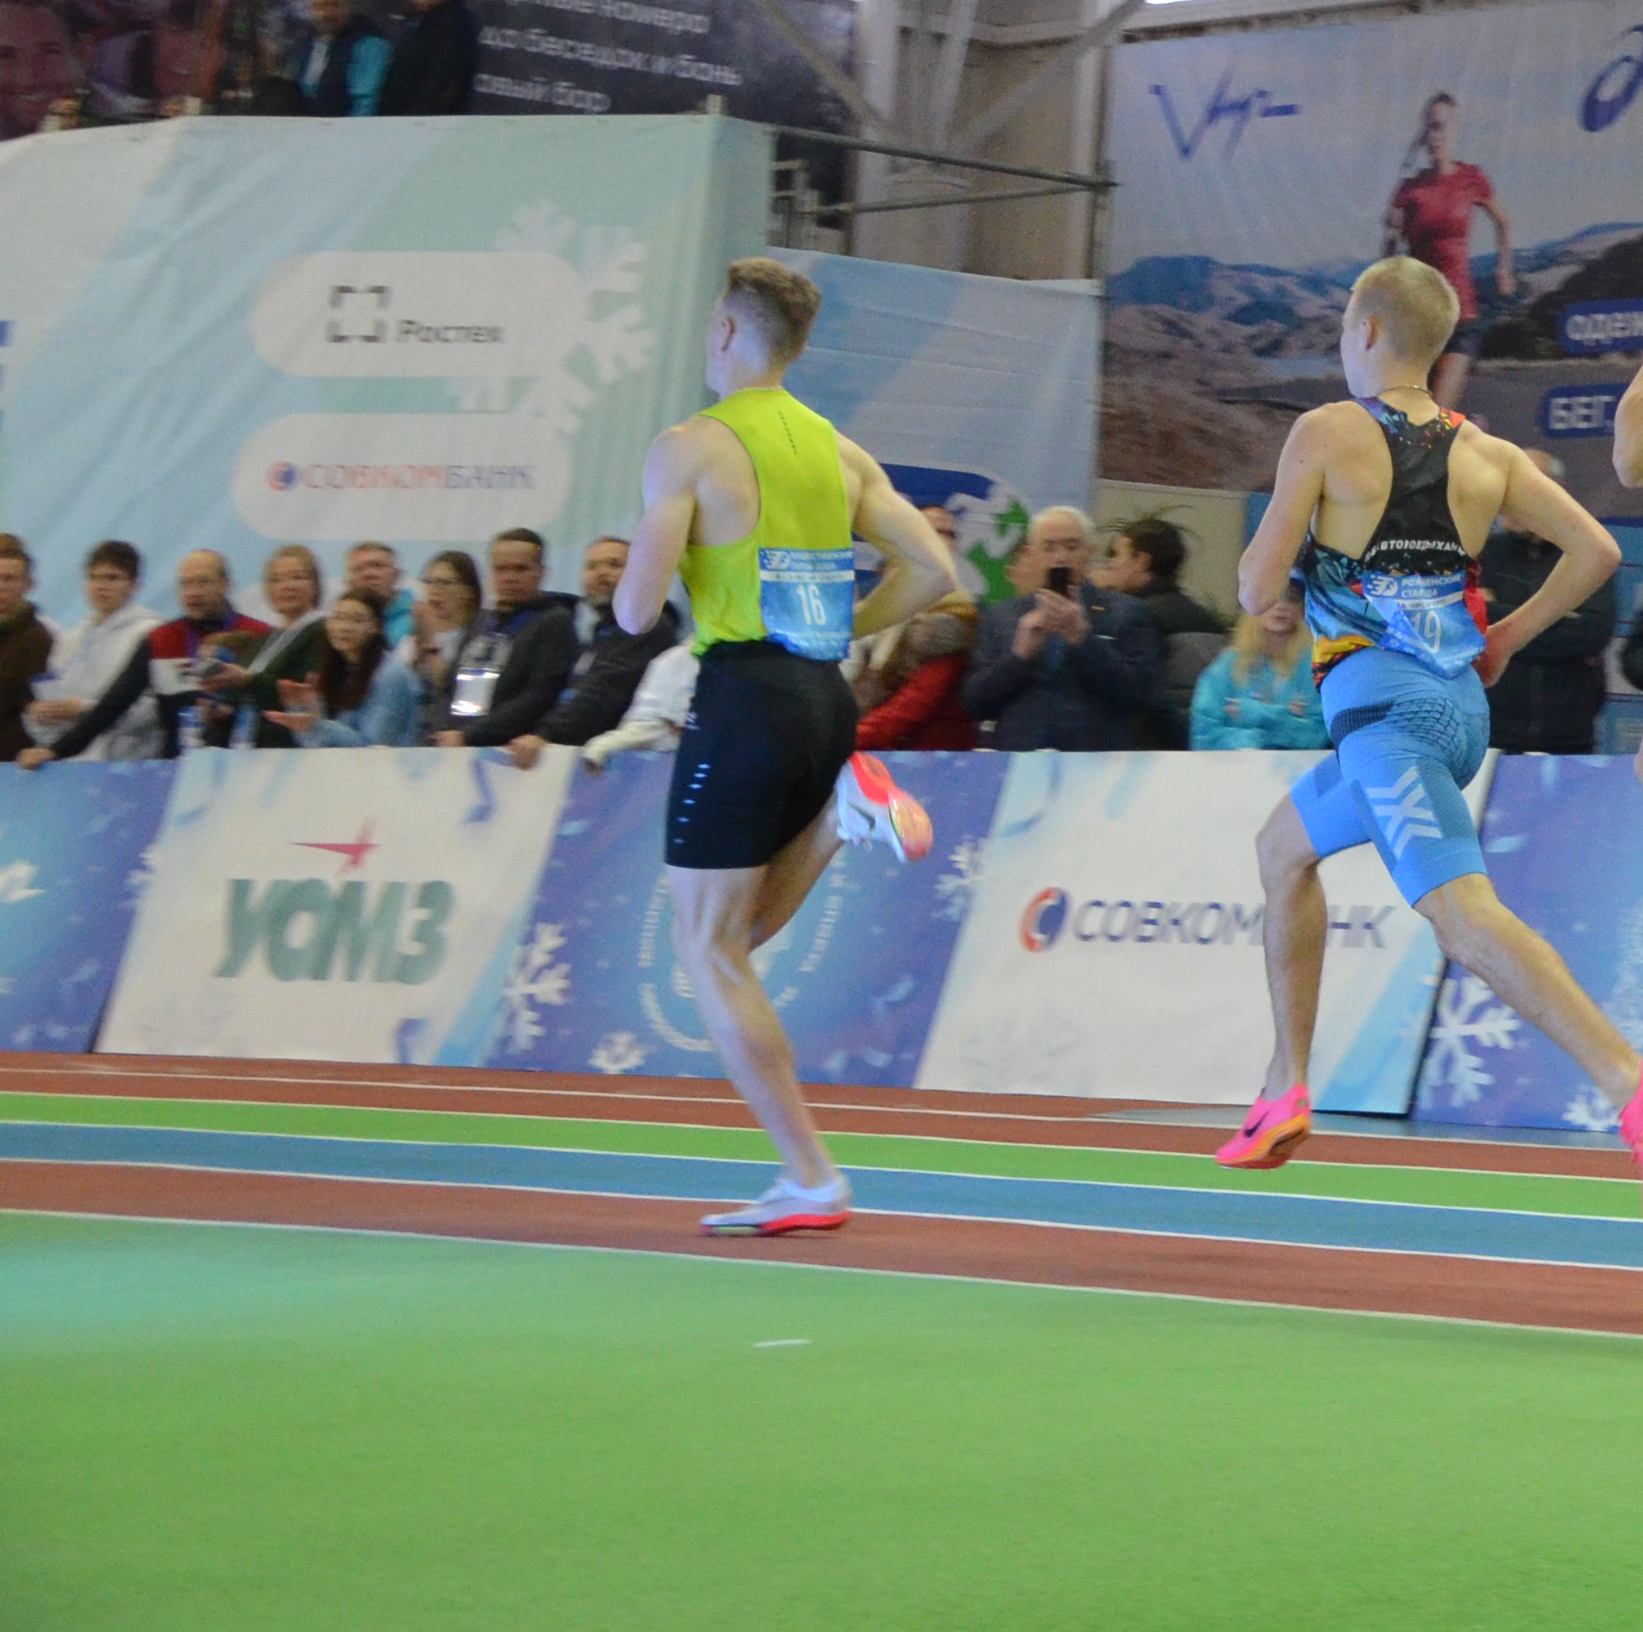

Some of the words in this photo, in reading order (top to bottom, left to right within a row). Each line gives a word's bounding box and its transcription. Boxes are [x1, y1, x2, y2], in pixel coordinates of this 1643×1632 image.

[397, 319, 506, 344] Ростех
[302, 464, 537, 489] СОВКОМБАНК
[796, 584, 826, 626] 16
[1410, 610, 1442, 654] 19
